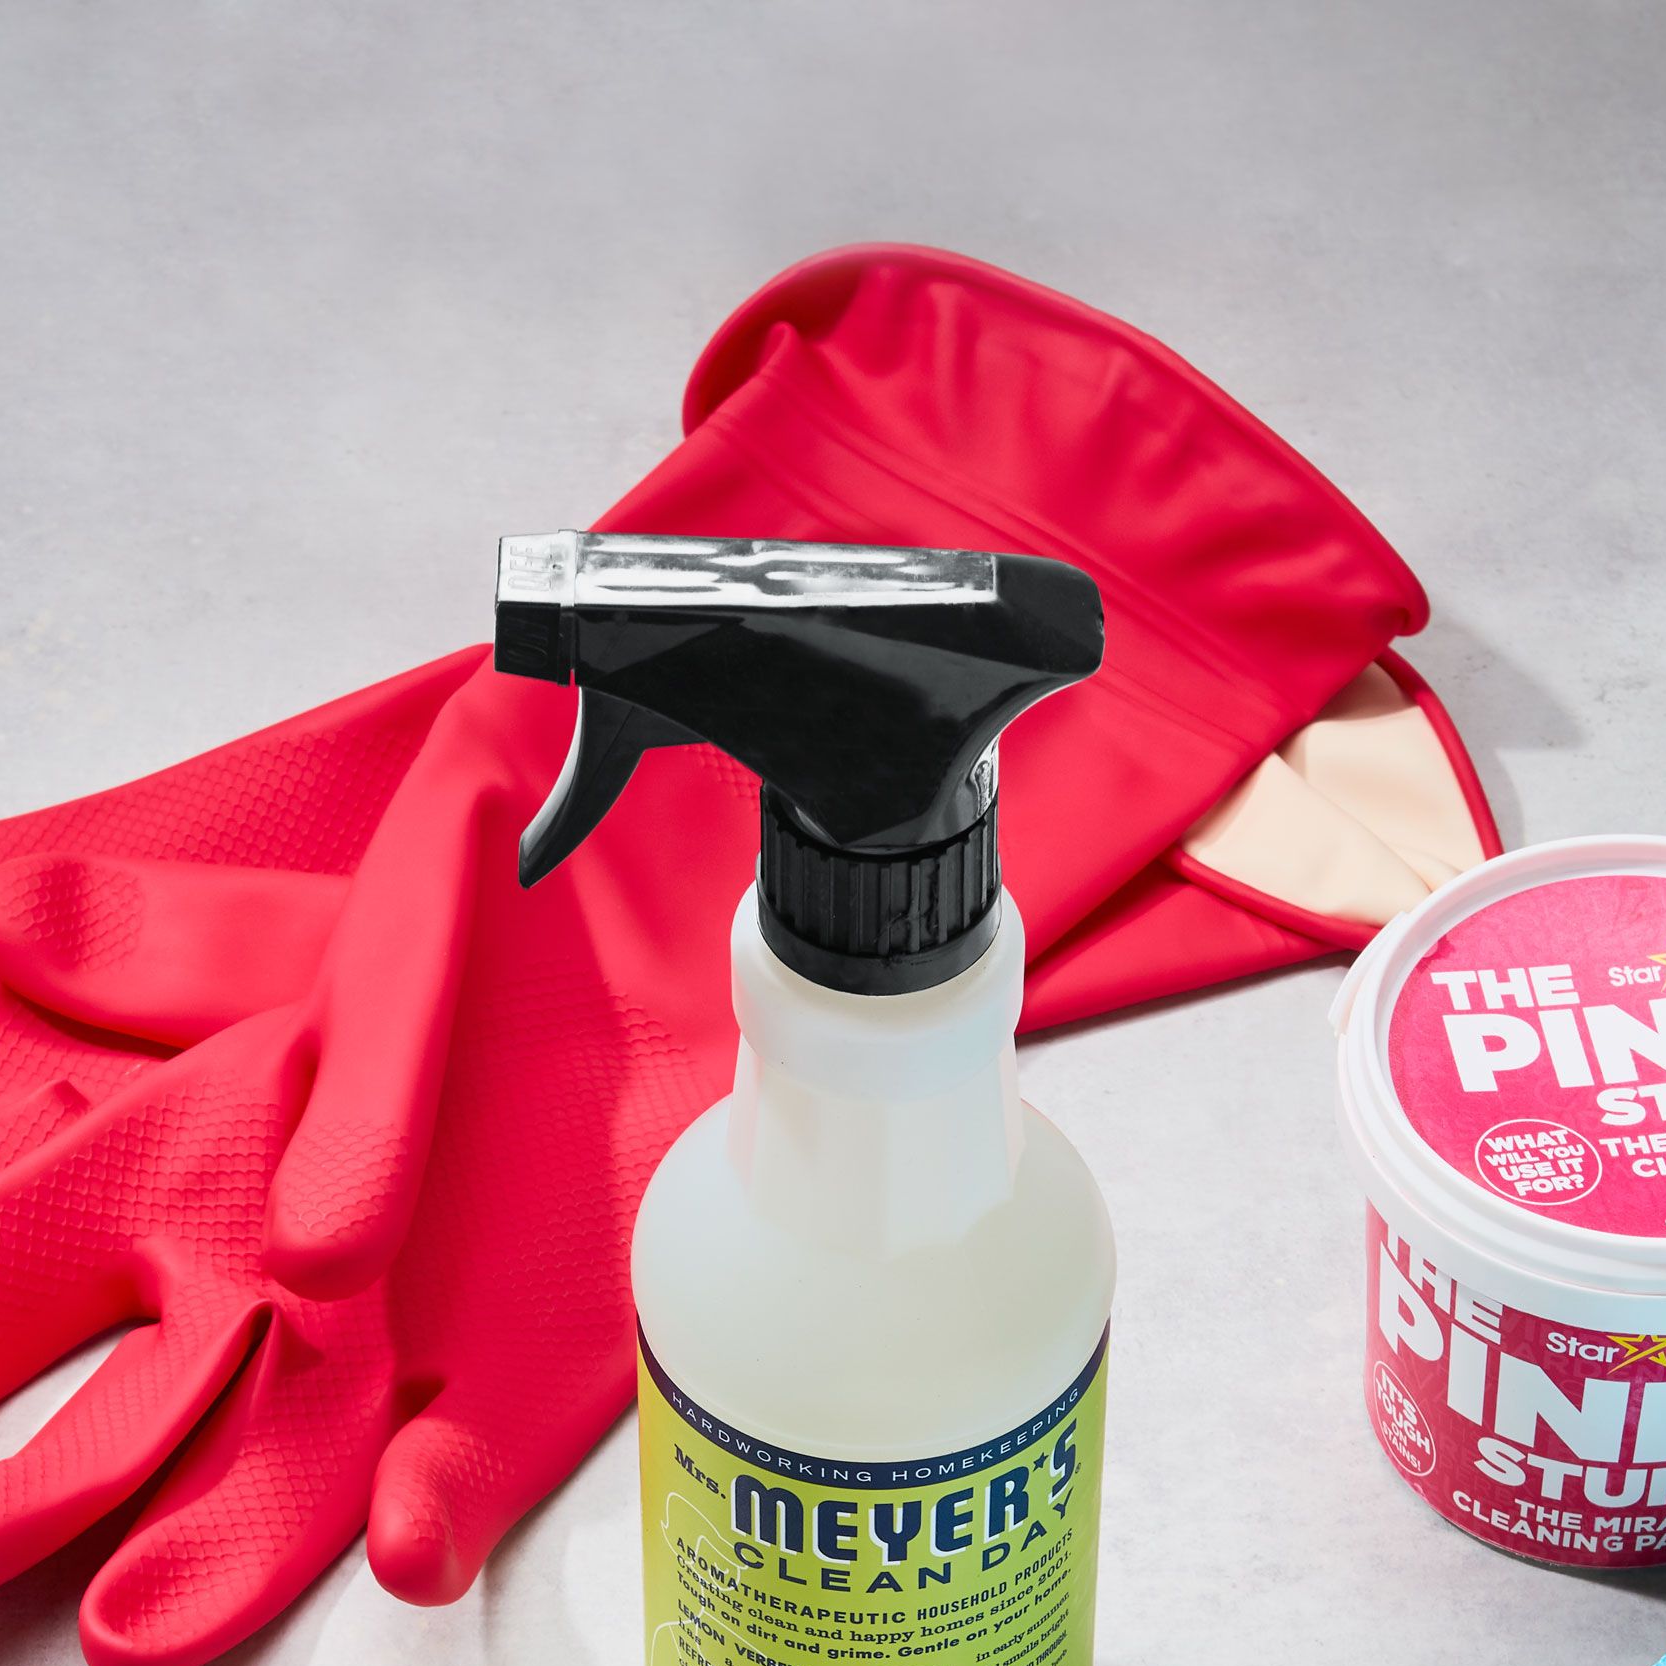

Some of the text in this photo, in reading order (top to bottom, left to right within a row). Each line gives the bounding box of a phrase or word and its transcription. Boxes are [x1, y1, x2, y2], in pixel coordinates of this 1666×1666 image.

[1430, 963, 1581, 1011] THE
[1607, 964, 1662, 988] Star
[1484, 1129, 1569, 1153] WHAT
[1484, 1143, 1586, 1167] WILL YOU
[1497, 1157, 1584, 1182] USE IT
[1513, 1173, 1585, 1197] FOR?
[1546, 1331, 1620, 1363] Star
[1375, 1377, 1431, 1455] TOUGH
[1381, 1368, 1418, 1425] IT'S
[672, 1388, 1078, 1482] HARDWORKING HOMEKEEPING
[1382, 1420, 1421, 1472] STAINS!
[1391, 1422, 1408, 1446] ON
[674, 1443, 727, 1500] Mrs.
[1452, 1490, 1624, 1553] CLEANING
[1514, 1498, 1583, 1531] THE
[734, 1486, 1074, 1594] CLEAN DAY
[676, 1528, 1072, 1625] AROMATHERAPEUTIC HOUSEHOLD PRODUCTS
[677, 1550, 1072, 1644] Creating clean and happy homes since 2001.
[677, 1568, 1071, 1660] Tough on dirt and grime. Gentle on your home.
[678, 1598, 725, 1646] LEMON
[678, 1616, 702, 1646] has
[1040, 1608, 1070, 1641] bright
[975, 1652, 991, 1663] in
[993, 1632, 1026, 1655] early
